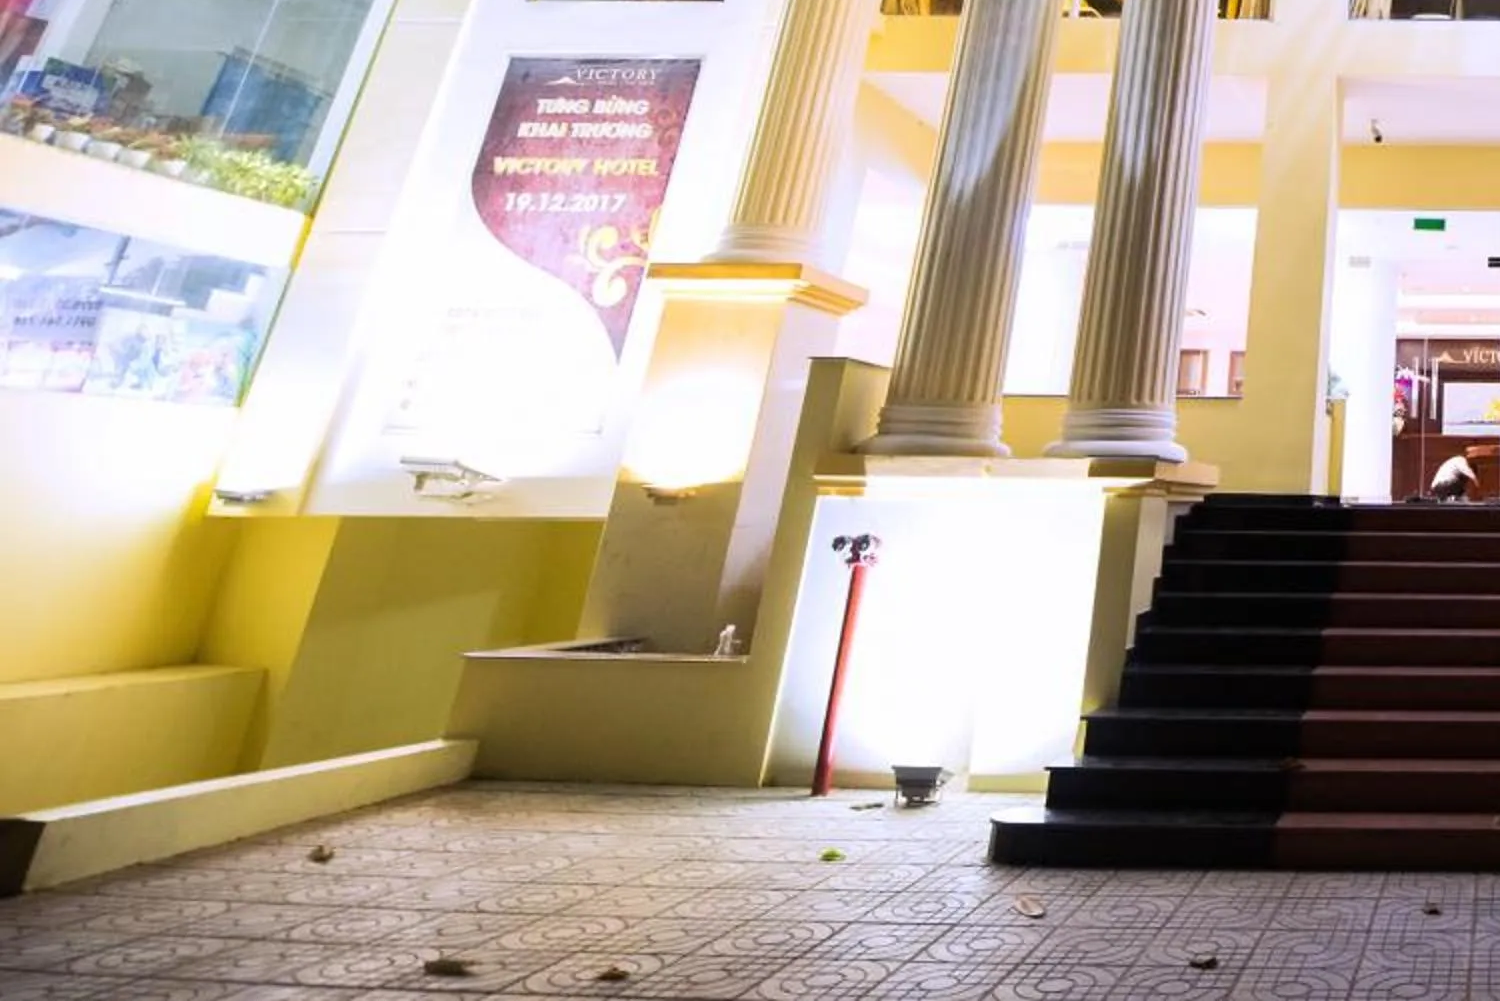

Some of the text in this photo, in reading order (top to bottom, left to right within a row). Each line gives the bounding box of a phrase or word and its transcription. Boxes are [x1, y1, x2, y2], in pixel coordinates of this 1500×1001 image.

[576, 68, 659, 80] VICTORY
[517, 121, 569, 138] KHAI
[493, 156, 660, 176] VICTORY HOTEL
[505, 192, 628, 212] 19.12.2017
